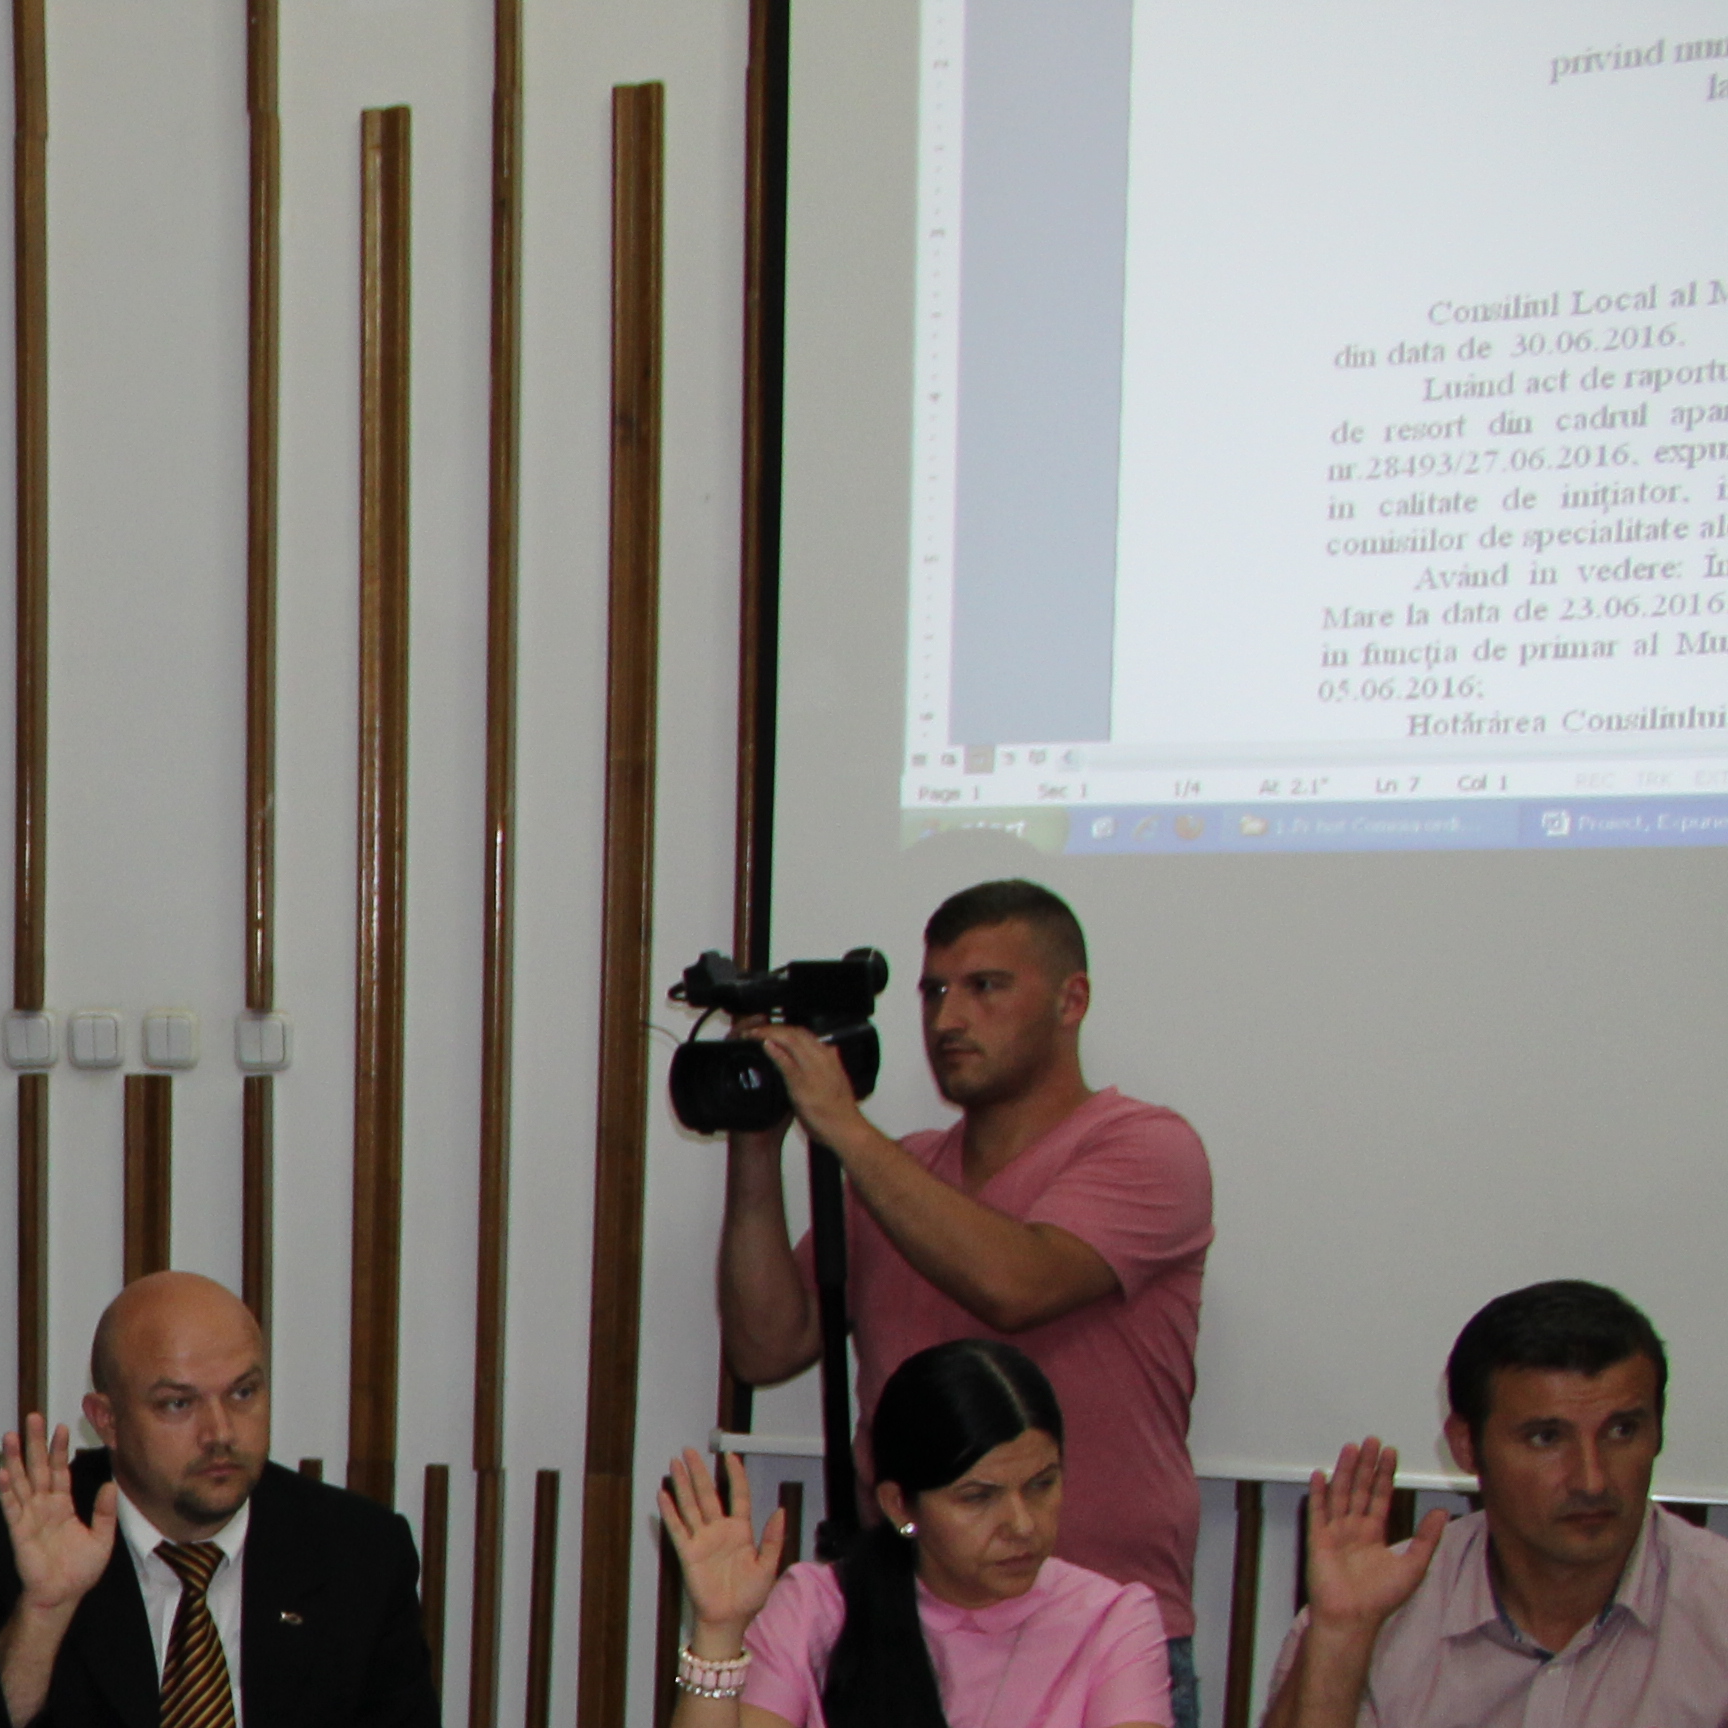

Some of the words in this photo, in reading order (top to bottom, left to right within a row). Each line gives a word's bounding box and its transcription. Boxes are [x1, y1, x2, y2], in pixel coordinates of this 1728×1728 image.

[1549, 38, 1666, 85] privind
[1428, 291, 1559, 326] Consiliul
[1571, 284, 1658, 316] Local
[1670, 281, 1698, 307] al
[1334, 344, 1376, 370] din
[1387, 340, 1446, 365] data
[1457, 336, 1493, 361] de
[1526, 369, 1569, 395] act
[1580, 366, 1616, 391] de
[1330, 420, 1364, 445] de
[1384, 415, 1466, 443] resort
[1488, 410, 1533, 436] din
[1556, 401, 1648, 431] cadrul
[1380, 490, 1478, 518] calitate
[1502, 487, 1538, 512] de
[1327, 529, 1468, 556] comisiilor
[1479, 525, 1515, 549] de
[1523, 518, 1689, 553] specialitate
[1322, 604, 1395, 631] Mare
[1406, 603, 1430, 627] la
[1442, 601, 1501, 626] data
[1513, 598, 1549, 622] de
[1473, 637, 1508, 664] de
[1519, 634, 1618, 667] primar
[1634, 631, 1659, 658] al
[1562, 704, 1727, 734] Consiliului
[1173, 780, 1201, 798] 1/4
[1375, 777, 1398, 794] Ln
[1457, 773, 1486, 792] Col
